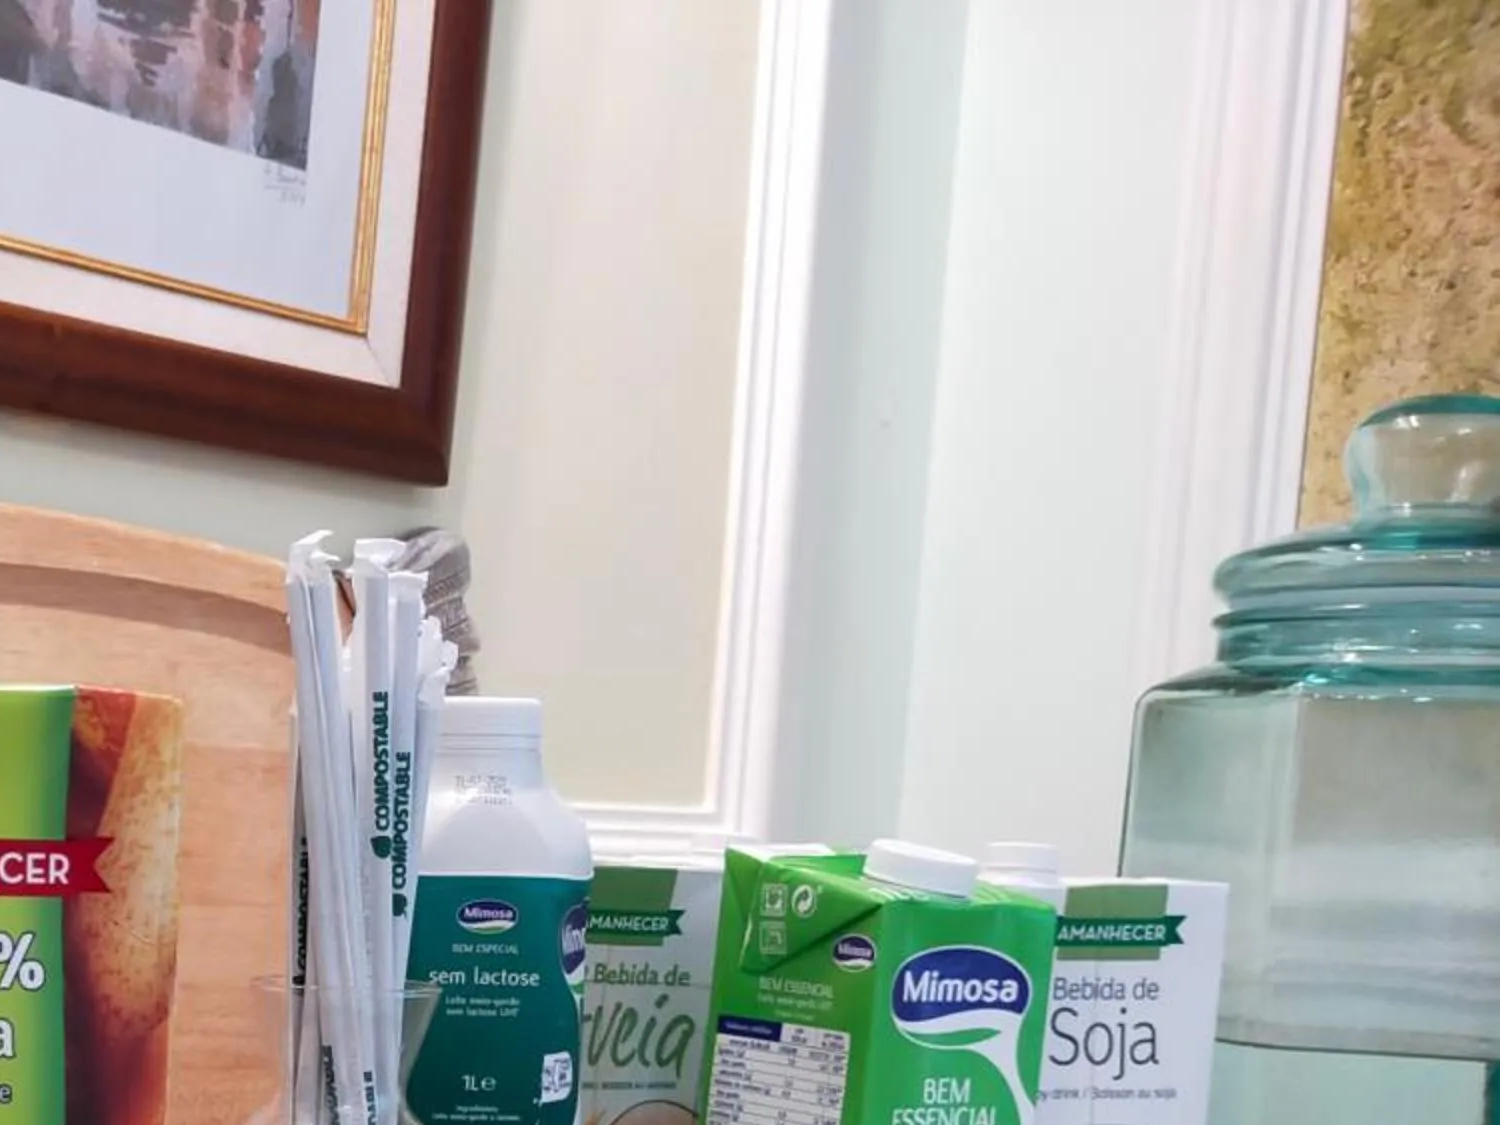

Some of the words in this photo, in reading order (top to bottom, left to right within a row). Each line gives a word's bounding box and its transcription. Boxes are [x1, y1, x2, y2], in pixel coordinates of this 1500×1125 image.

[372, 691, 390, 831] COMPOSTABLE
[391, 751, 411, 890] COMPOSTABLE
[464, 908, 513, 920] Mimosa
[586, 914, 669, 931] MANHECER
[1056, 924, 1167, 941] AMANHECER
[429, 970, 466, 984] sem
[474, 966, 541, 987] lactose
[594, 962, 659, 985] Bebida
[663, 963, 691, 986] de
[902, 969, 1020, 1004] Mimosa
[1052, 976, 1126, 1001] Bebida
[1131, 977, 1160, 1001] de
[581, 994, 695, 1079] veia
[1049, 1006, 1160, 1081] Soja
[923, 1077, 972, 1105] BEM
